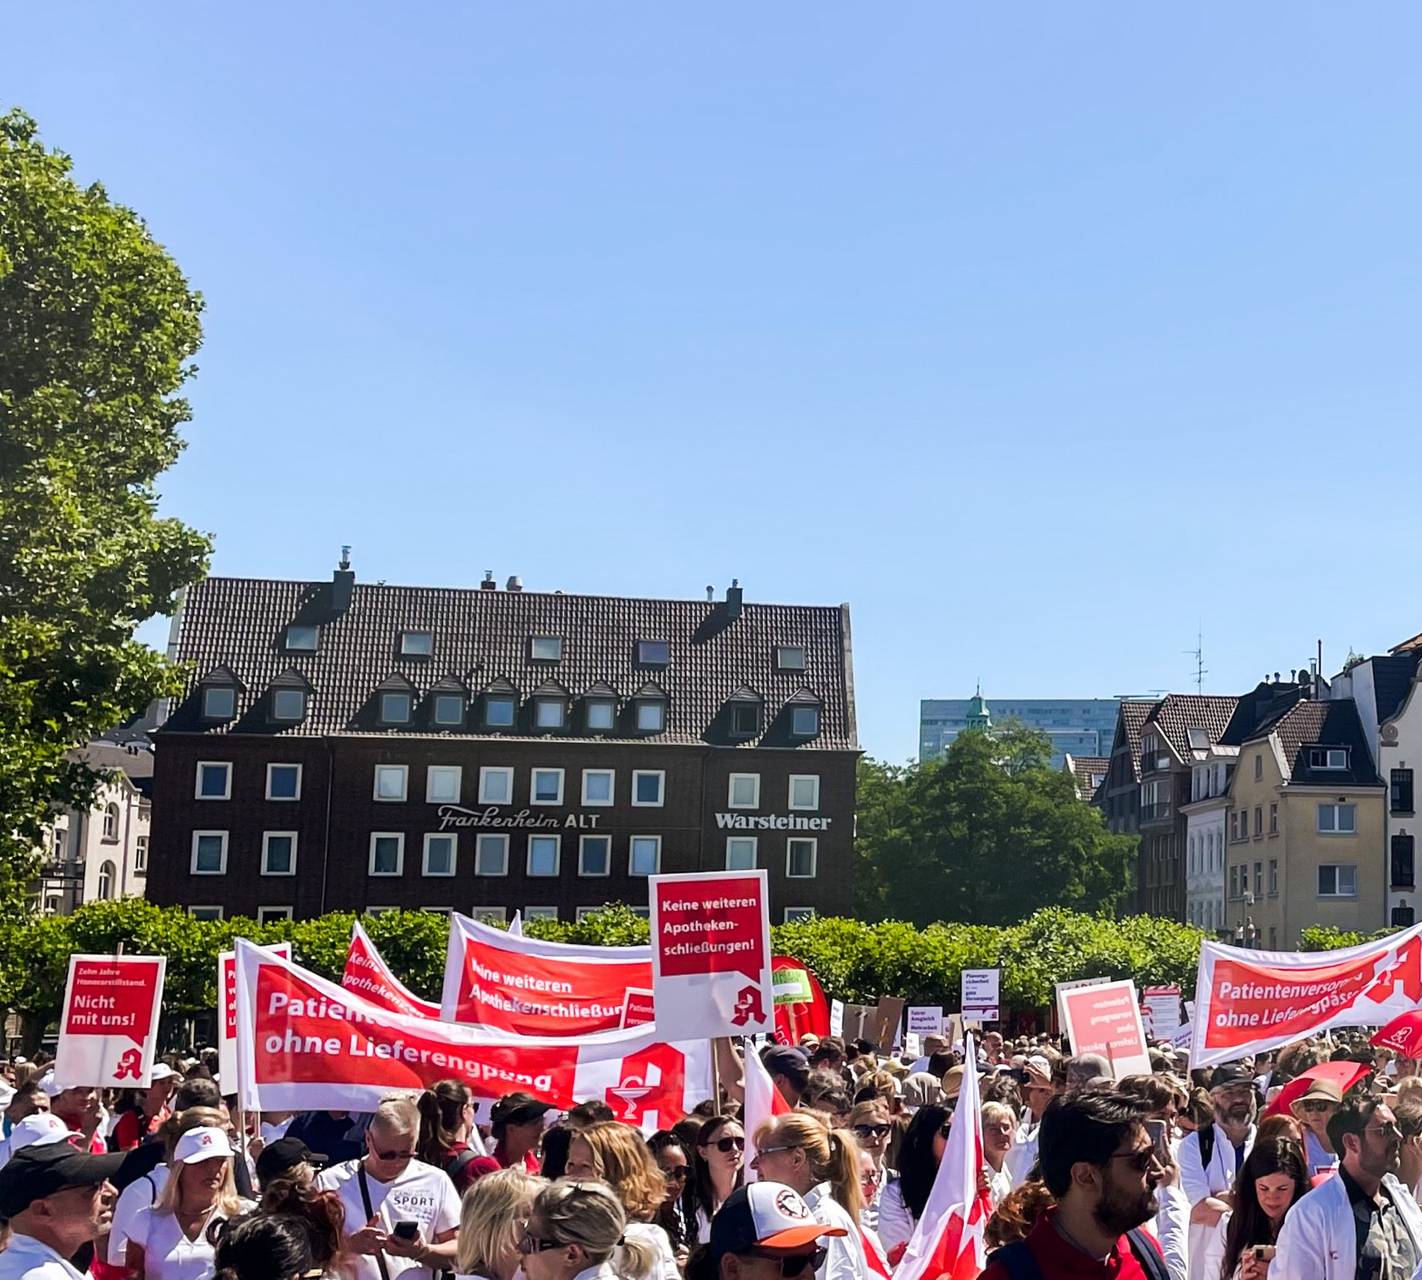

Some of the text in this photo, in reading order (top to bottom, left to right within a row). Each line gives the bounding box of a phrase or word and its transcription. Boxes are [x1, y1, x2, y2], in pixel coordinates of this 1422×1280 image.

[437, 804, 600, 831] Frankenheim ALT
[715, 812, 832, 830] Warsteiner
[662, 897, 757, 911] Keine weiteren
[663, 919, 739, 936] Apotheken-
[664, 939, 754, 956] schließungen!
[503, 973, 572, 993] weiteren
[74, 995, 115, 1009] Nicht
[72, 1011, 136, 1026] mit uns!
[1216, 1008, 1260, 1027] ohne
[265, 1029, 341, 1055] ohne
[394, 1196, 434, 1206] SPORT
